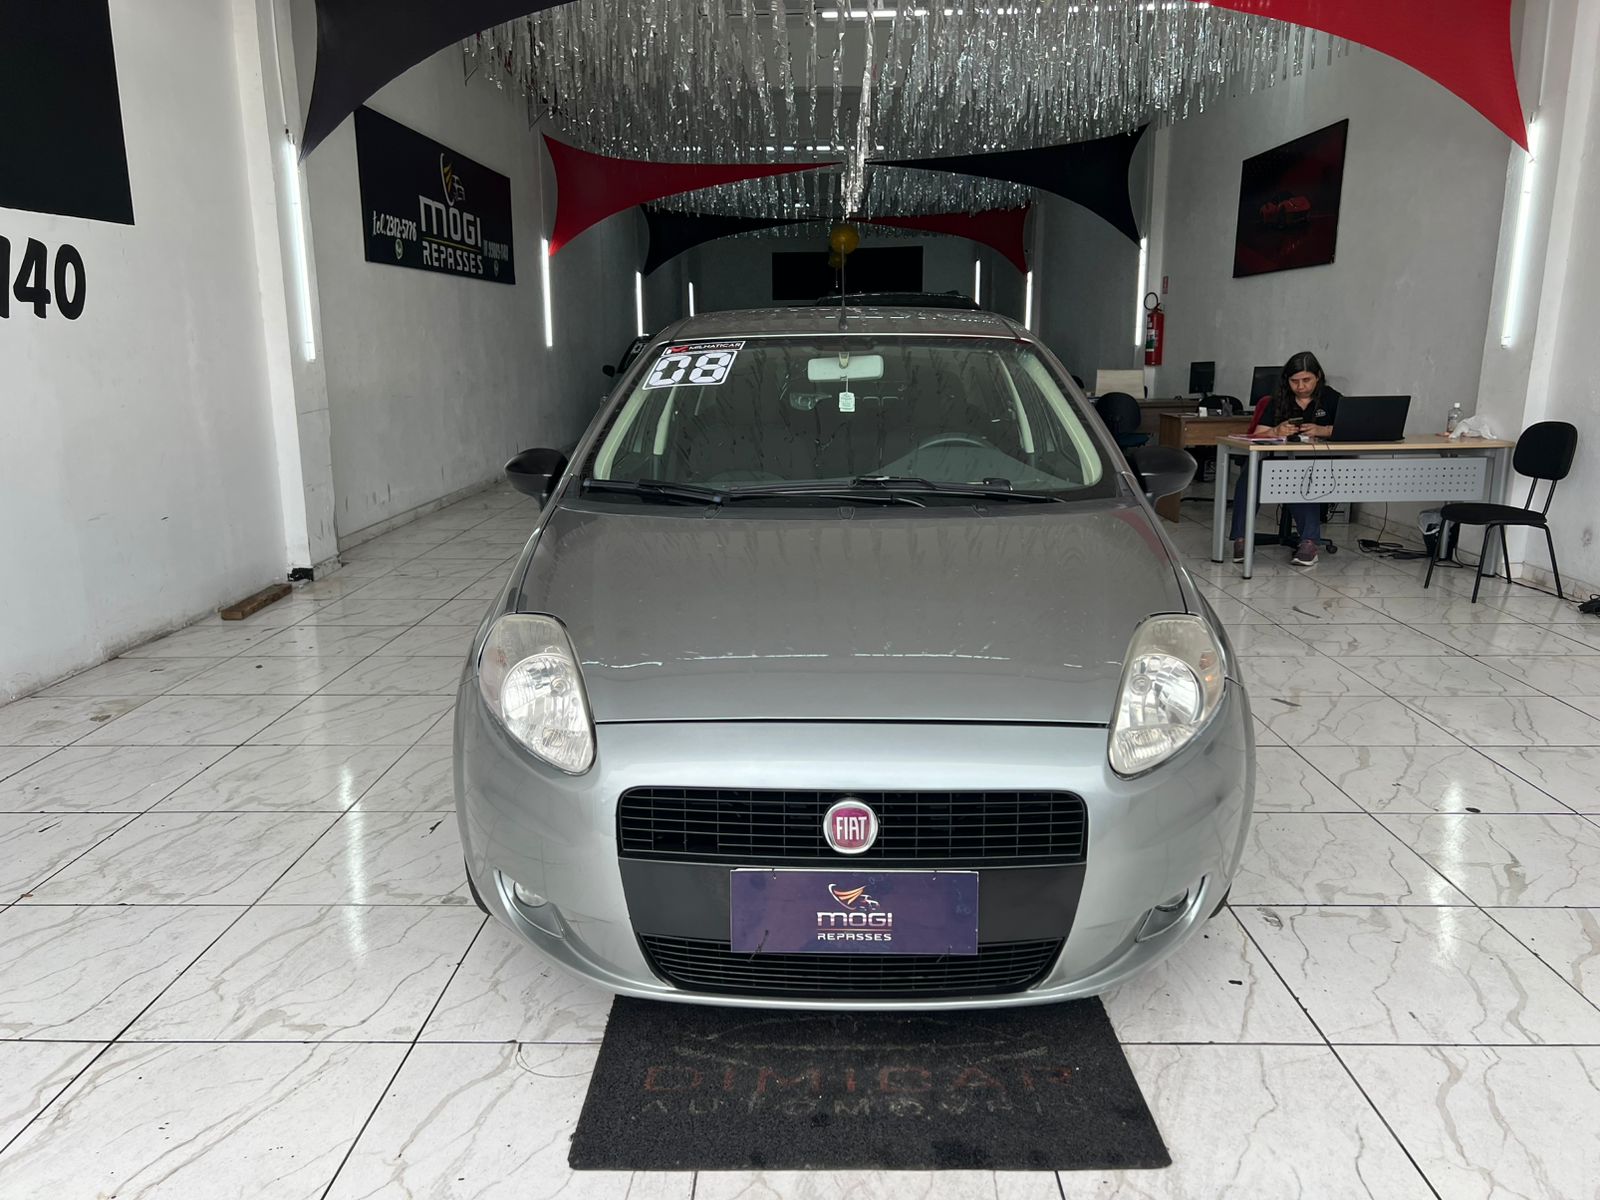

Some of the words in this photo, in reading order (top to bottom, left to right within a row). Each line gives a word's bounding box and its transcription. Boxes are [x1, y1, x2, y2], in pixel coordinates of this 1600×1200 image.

[419, 194, 482, 248] MOGI
[422, 240, 484, 275] REPASSES
[648, 352, 732, 386] 08
[836, 816, 868, 841] FIAT
[816, 911, 893, 927] MOGI
[816, 932, 893, 942] REPASSES
